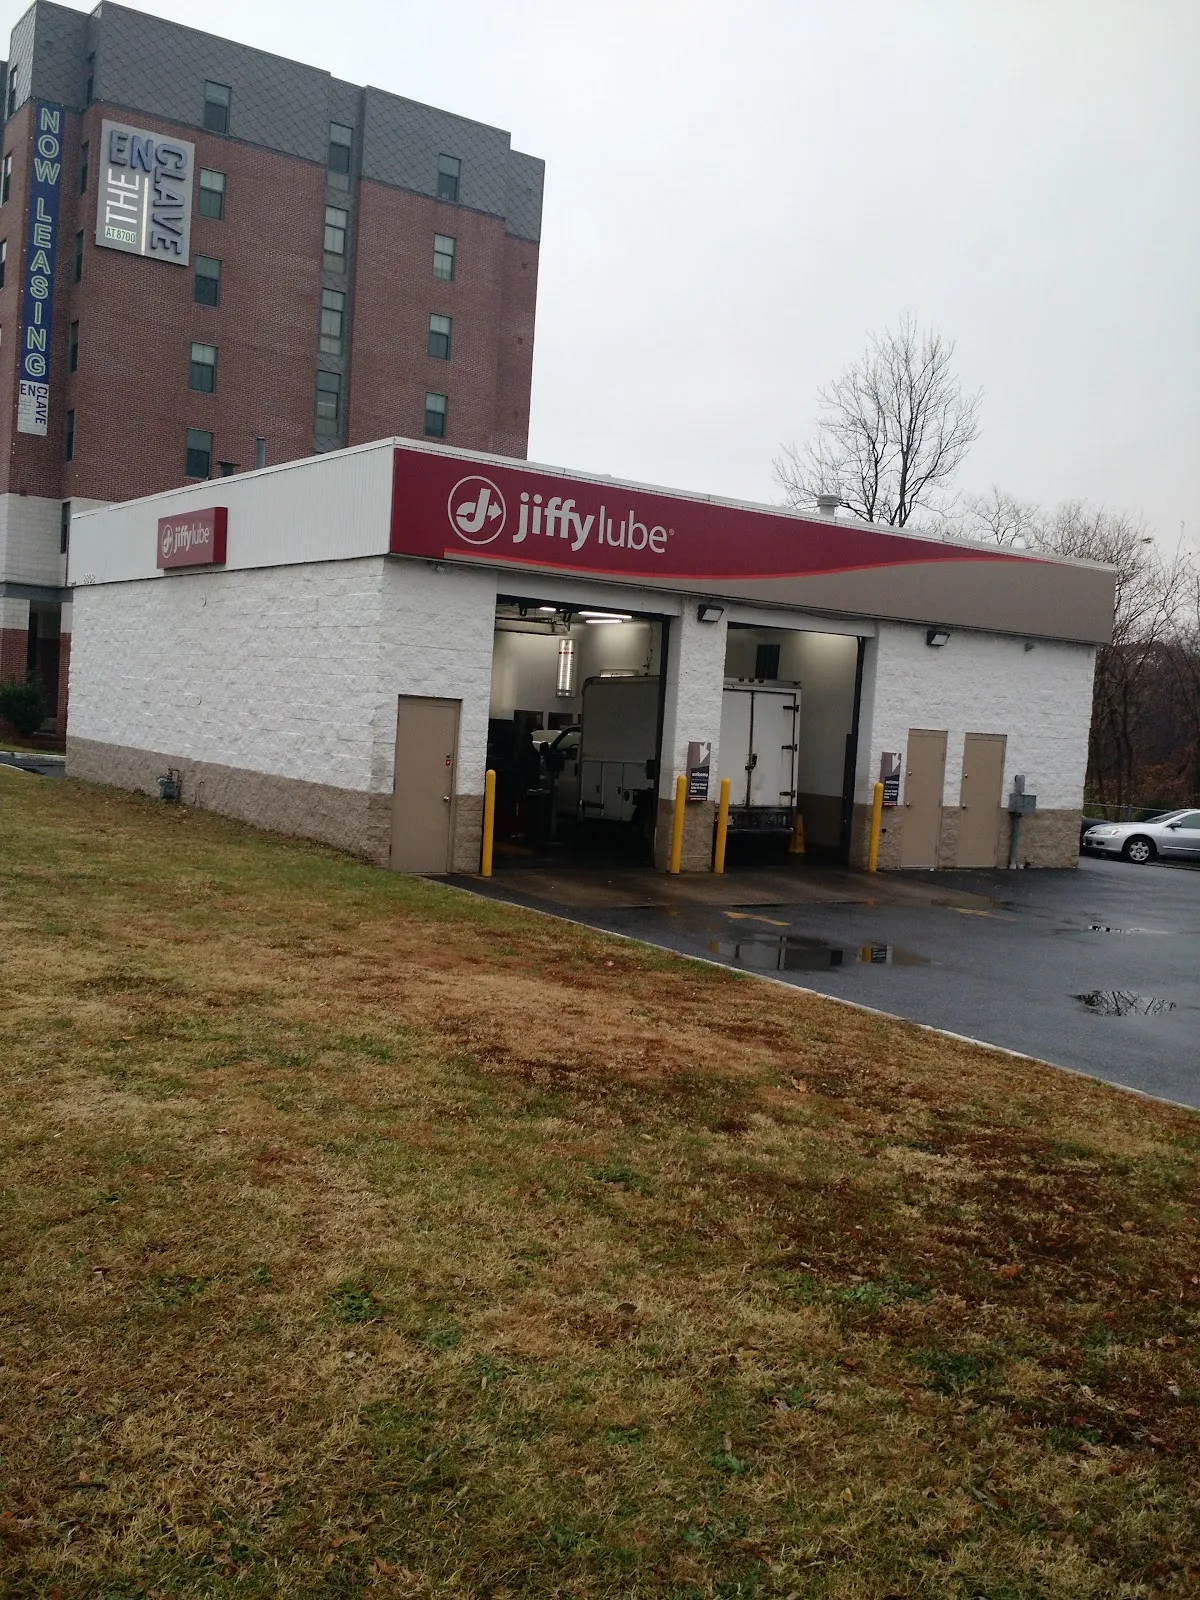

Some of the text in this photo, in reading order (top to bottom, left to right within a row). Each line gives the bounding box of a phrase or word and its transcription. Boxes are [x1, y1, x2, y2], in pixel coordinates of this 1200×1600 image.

[109, 130, 154, 172] EN
[106, 168, 139, 224] THE
[151, 143, 187, 255] CLAVE
[25, 107, 60, 376] NOW LEASING
[106, 227, 136, 243] AT 8700
[20, 383, 36, 397] EN
[35, 386, 48, 426] CLAVE
